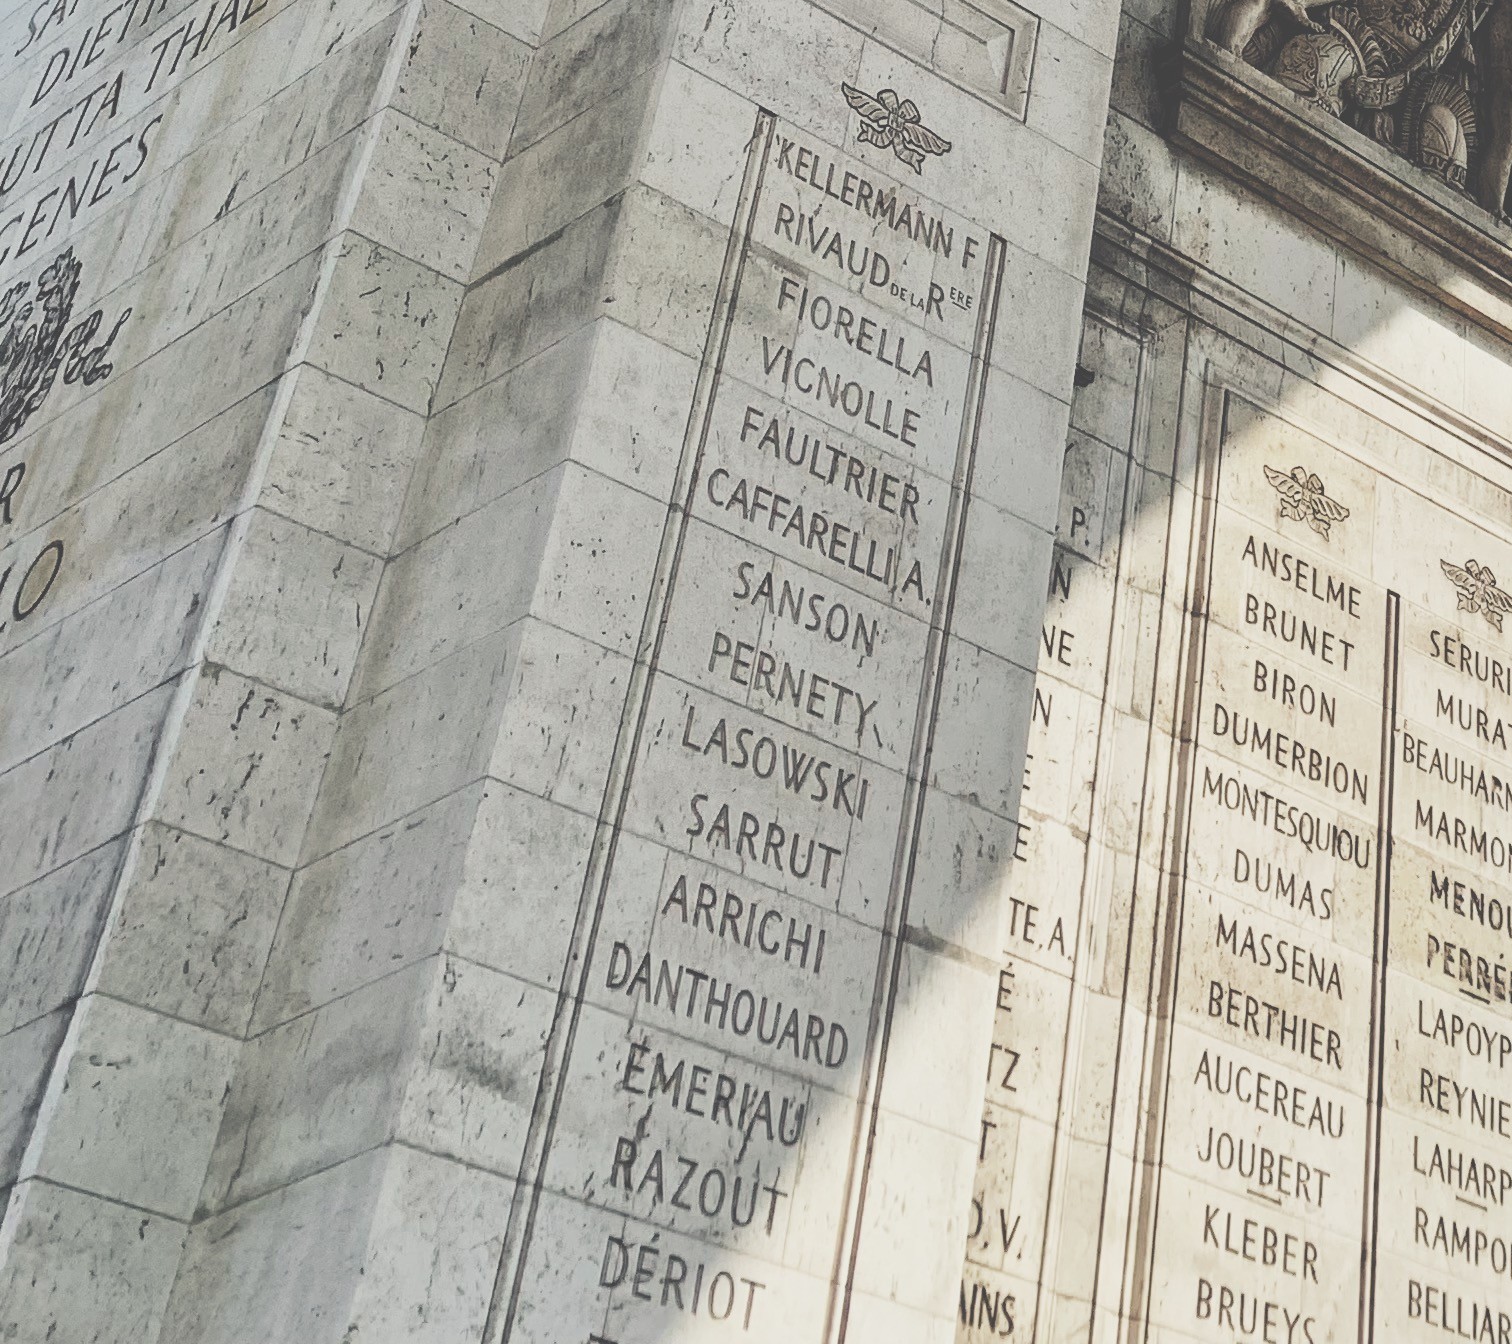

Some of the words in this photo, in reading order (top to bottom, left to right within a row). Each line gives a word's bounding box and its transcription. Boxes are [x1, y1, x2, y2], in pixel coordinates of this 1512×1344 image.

[0, 70, 124, 197] UTTA
[777, 141, 953, 260] KELLERMANN
[774, 202, 890, 288] RIVAUD
[891, 282, 907, 302] DE
[910, 292, 925, 312] LA
[778, 277, 933, 388] FIORELLA
[740, 406, 920, 525] FAULTRIER
[707, 468, 894, 586] CAFFARELLI
[733, 561, 878, 657] SANSON
[1242, 535, 1362, 620] ANSELME
[1245, 593, 1355, 672] BRUNET
[708, 632, 877, 748] PERNETY
[1253, 660, 1336, 728] BIRON
[681, 705, 868, 822] LASOWSKI
[1213, 703, 1368, 806] DUMERBION
[686, 794, 842, 889] SARRUT
[1202, 766, 1371, 871] MONTESQUIOU
[661, 875, 826, 974] ARRICHI
[1234, 848, 1333, 920] DUMAS
[605, 941, 848, 1070] DANTHOUARD
[1216, 913, 1343, 1001] MASSENA
[1208, 980, 1343, 1070] BERTHIER
[1194, 1049, 1345, 1139] AUGEREAU
[609, 1136, 789, 1237] RAZOUT
[1197, 1127, 1331, 1208] JOUBERT
[1202, 1204, 1319, 1285] KLEBER
[1196, 1277, 1315, 1344] BRUEYS
